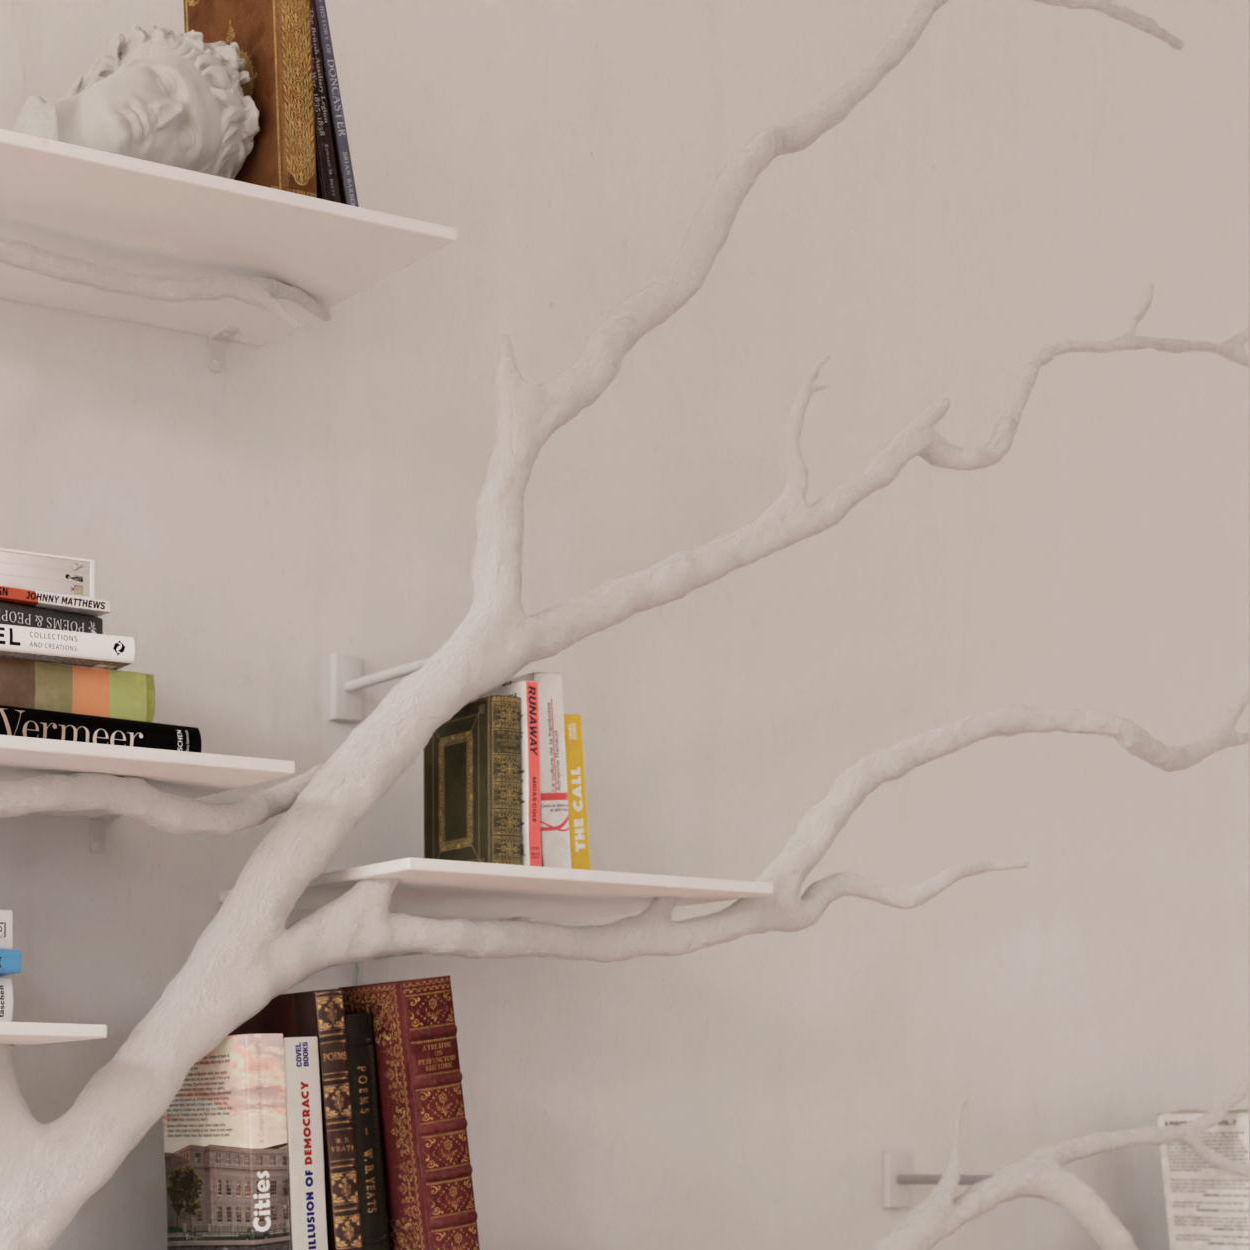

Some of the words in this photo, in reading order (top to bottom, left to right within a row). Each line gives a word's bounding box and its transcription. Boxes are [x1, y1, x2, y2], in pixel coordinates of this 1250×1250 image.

[319, 6, 329, 40] HISTORY
[326, 59, 346, 137] DONCASTER
[316, 57, 324, 94] Auxiliary
[320, 96, 328, 123] Legion
[342, 151, 351, 175] BRIAN
[26, 591, 59, 604] JOHNNY
[61, 597, 105, 610] MATTHEWS
[29, 632, 78, 642] COLLECTIONS
[46, 617, 85, 632] POEMS
[46, 642, 78, 652] CREATIONS
[528, 686, 538, 756] RUNAWAY
[570, 767, 583, 812] CALL
[574, 818, 586, 852] THE
[323, 1051, 347, 1062] POEMS
[418, 1054, 456, 1065] PERFUNCTORY
[427, 1042, 452, 1050] TREATISE
[425, 1062, 452, 1072] RHETORIC
[357, 1066, 370, 1114] POEMS
[300, 1081, 312, 1165] DEMOCRACY
[305, 1170, 313, 1187] OF
[253, 1170, 271, 1232] Cities
[365, 1177, 377, 1214] YEATS
[306, 1192, 316, 1250] ILLUSION
